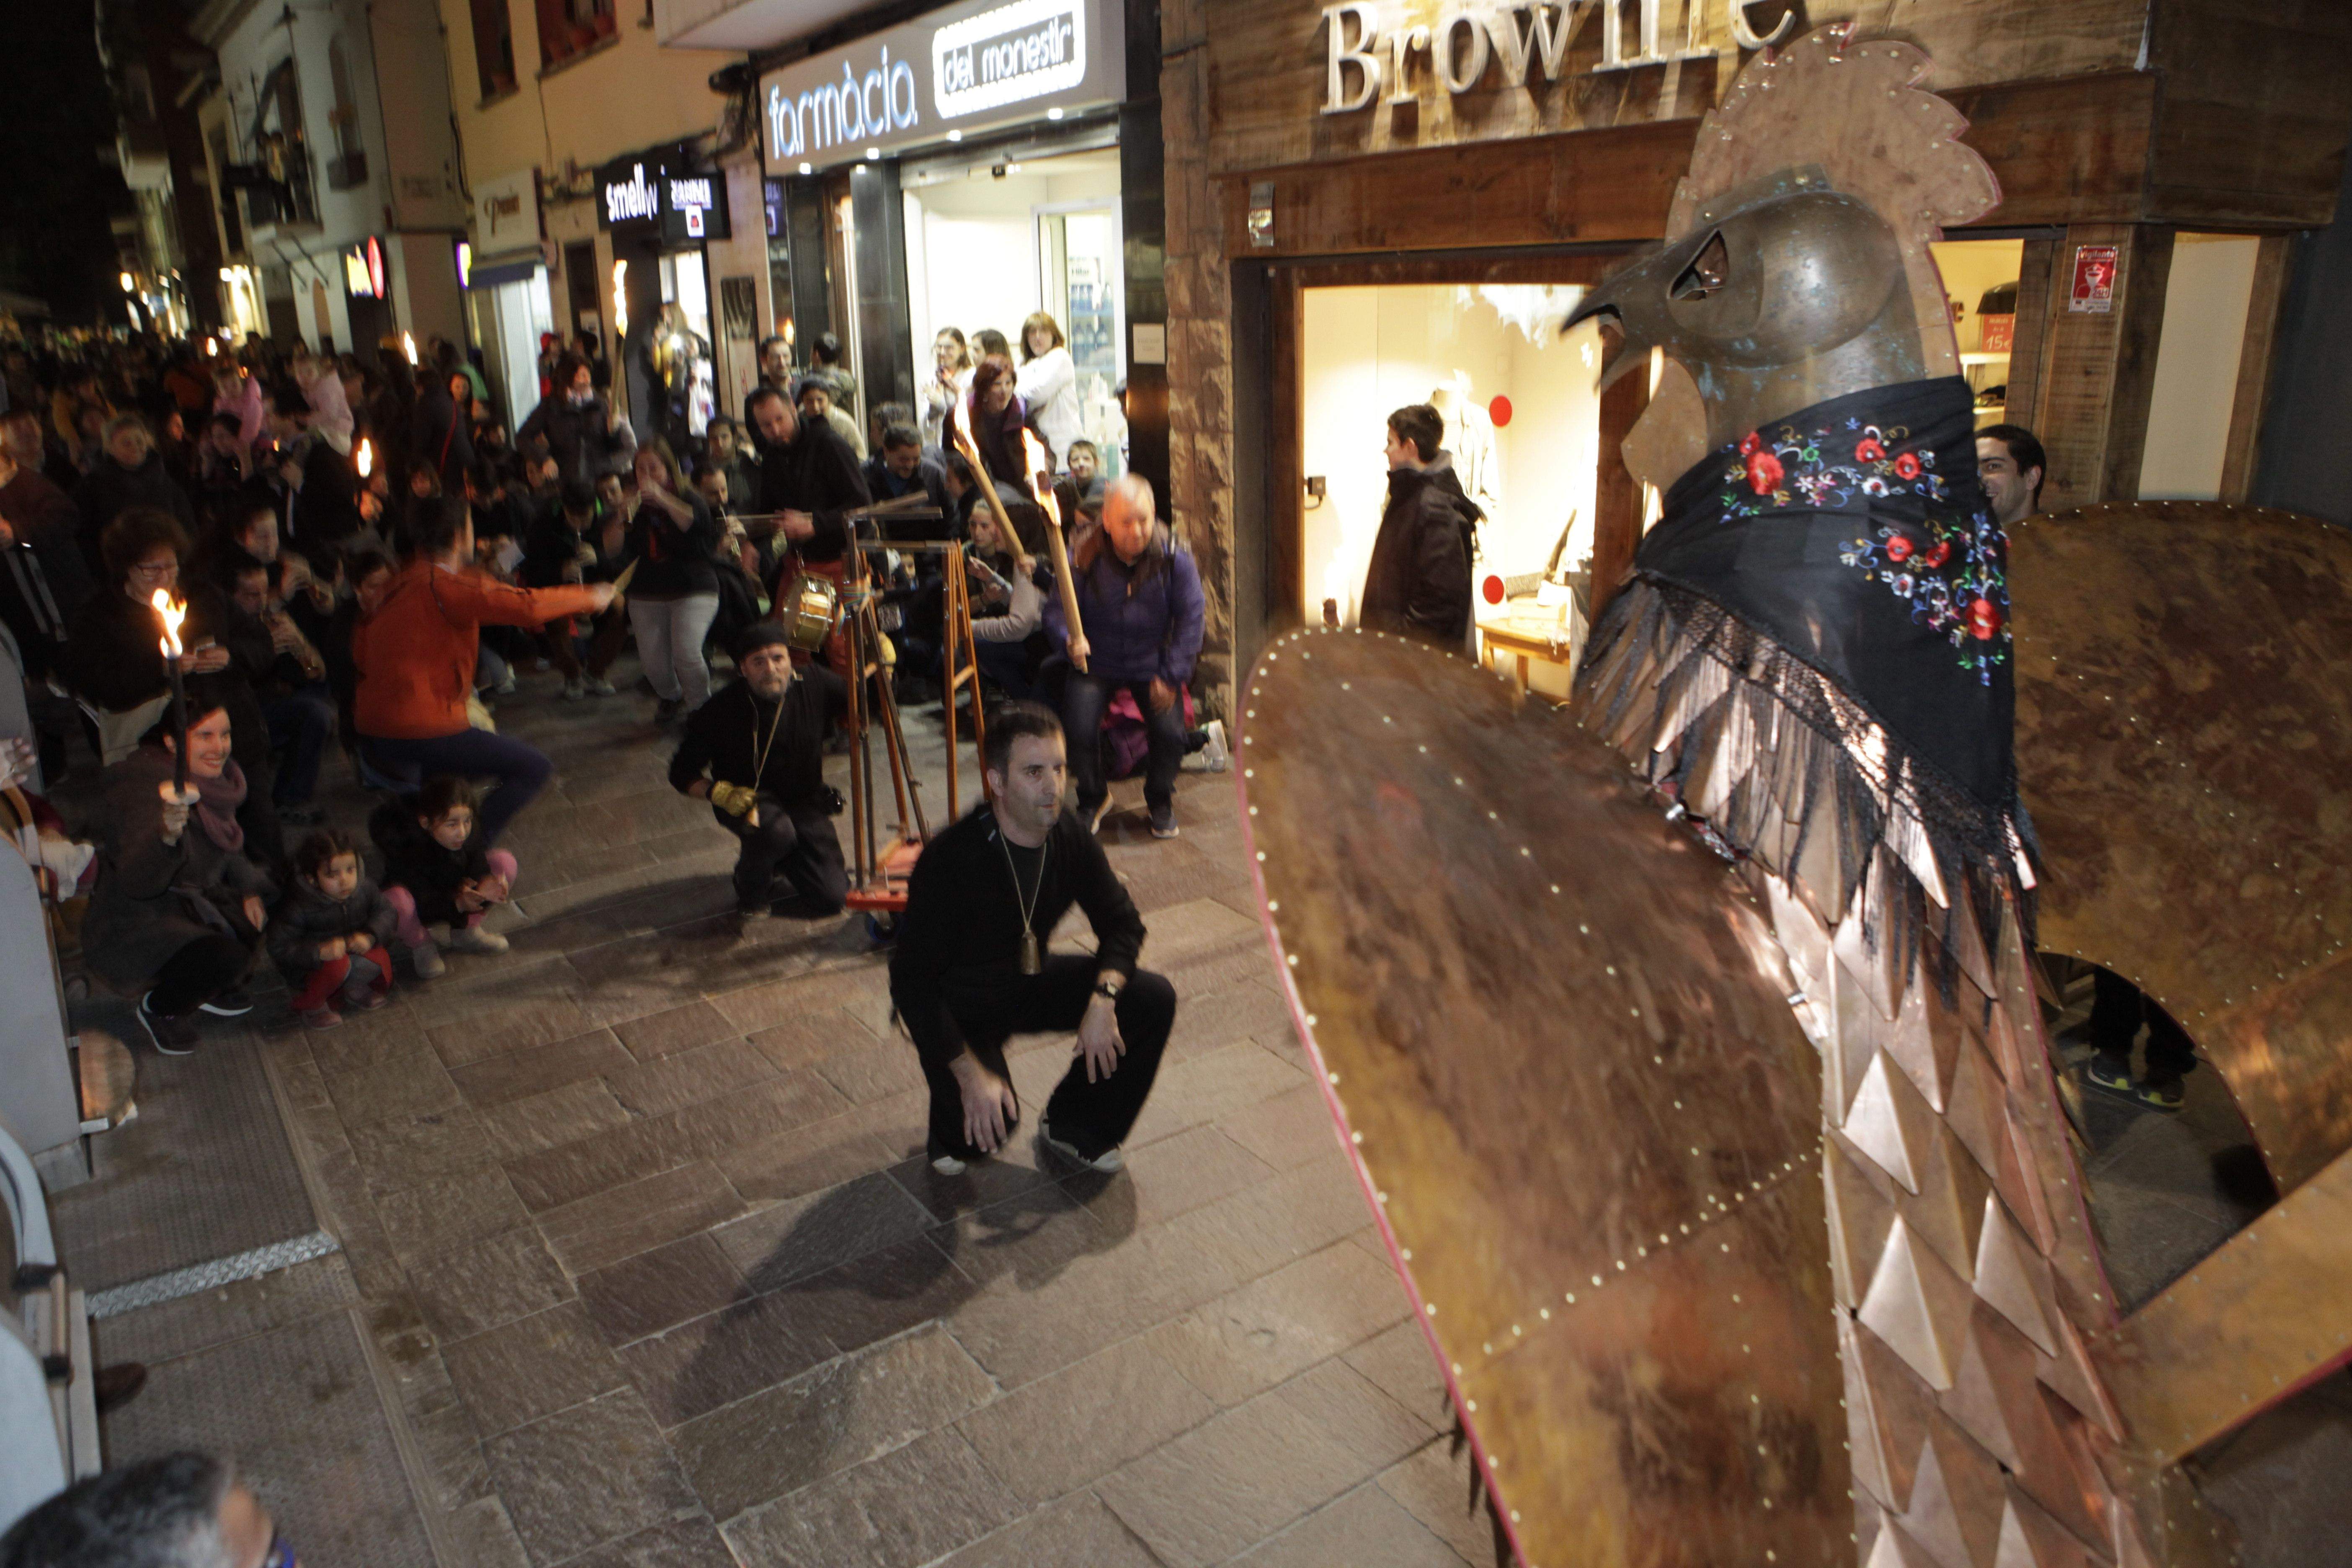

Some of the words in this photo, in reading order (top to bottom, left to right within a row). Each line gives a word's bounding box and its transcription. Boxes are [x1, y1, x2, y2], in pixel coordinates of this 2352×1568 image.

[945, 43, 975, 92] del
[982, 15, 1072, 83] monestir
[769, 44, 918, 160] farmàcia
